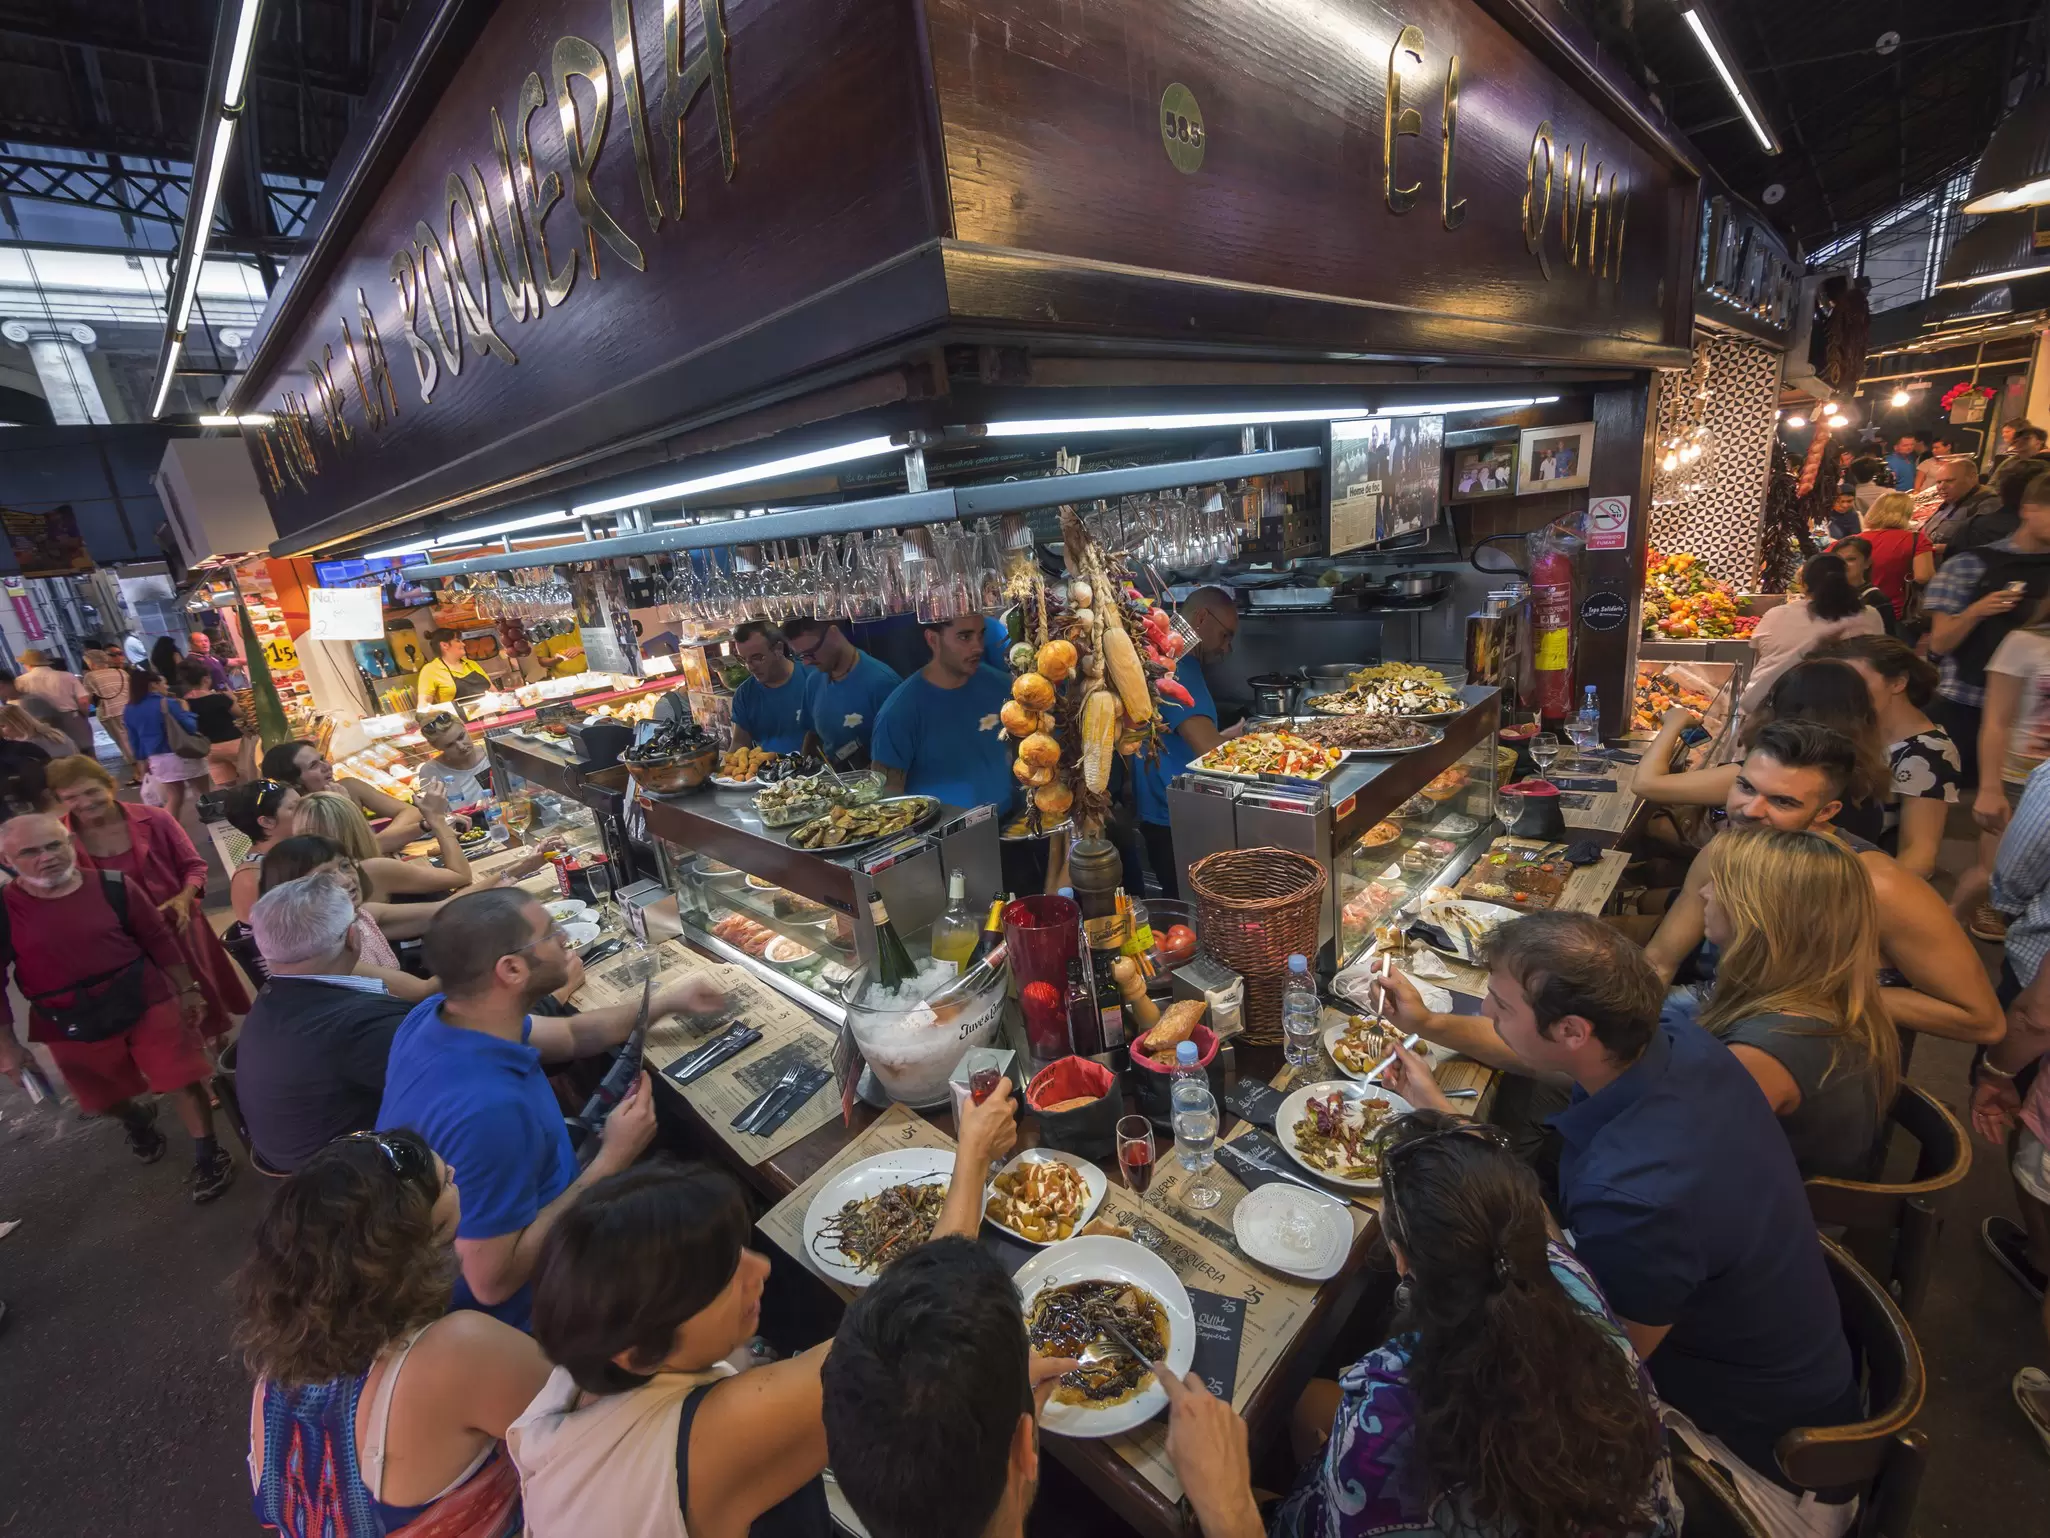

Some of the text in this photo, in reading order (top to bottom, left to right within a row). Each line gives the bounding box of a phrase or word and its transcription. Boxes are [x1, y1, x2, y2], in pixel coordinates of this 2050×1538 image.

[1165, 110, 1202, 148] 585
[1384, 24, 1467, 230] EL
[340, 288, 399, 432] LA
[390, 0, 737, 404] BOQUERIA
[1349, 482, 1380, 497] Home de foc
[901, 1124, 918, 1140] 25
[1103, 1202, 1118, 1214] EL
[1170, 1241, 1227, 1284] BOQUERIA
[1243, 1284, 1265, 1305] 25
[1221, 1298, 1237, 1313] 25
[1198, 1312, 1226, 1327] QUIM
[1207, 1377, 1224, 1396] 25
